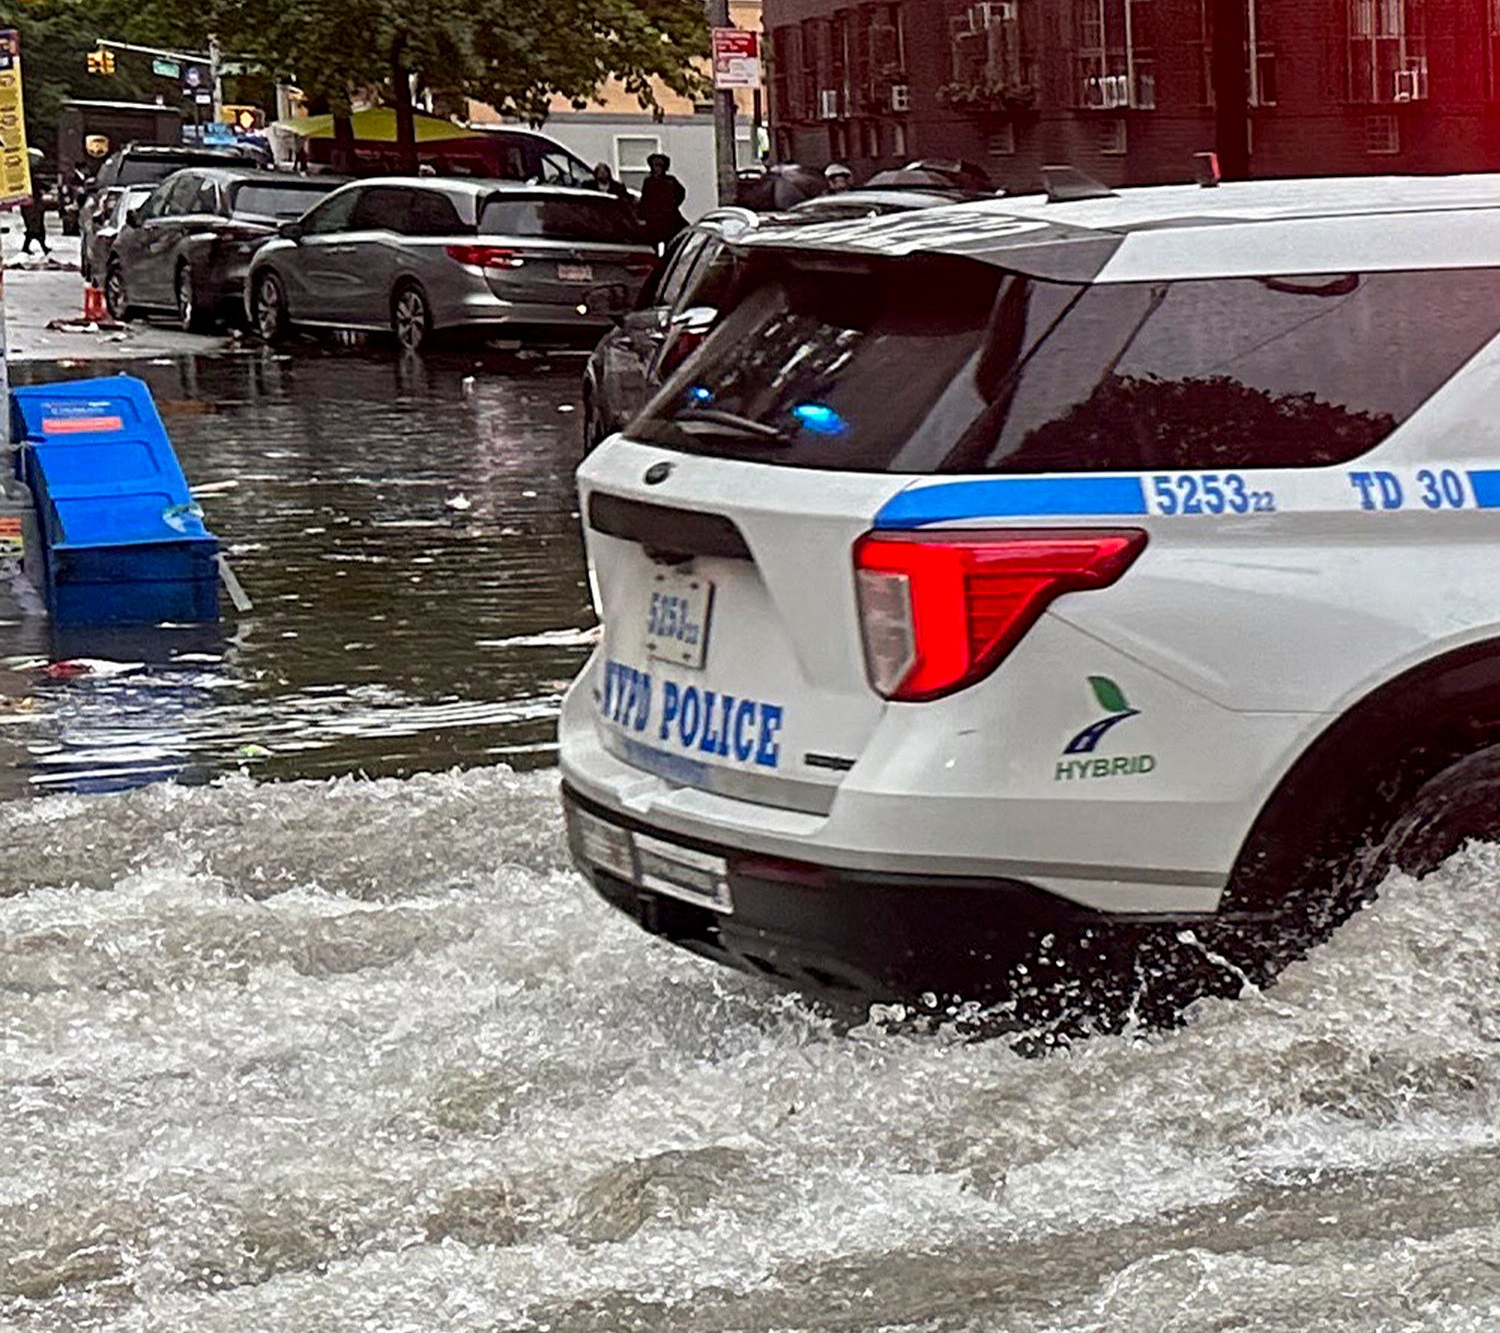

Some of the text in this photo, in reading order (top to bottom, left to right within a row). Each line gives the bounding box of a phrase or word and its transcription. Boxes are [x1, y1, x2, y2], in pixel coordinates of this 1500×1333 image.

[1348, 469, 1465, 511] TD 30
[659, 680, 784, 769] POLICE
[1054, 754, 1157, 782] HYBRID
